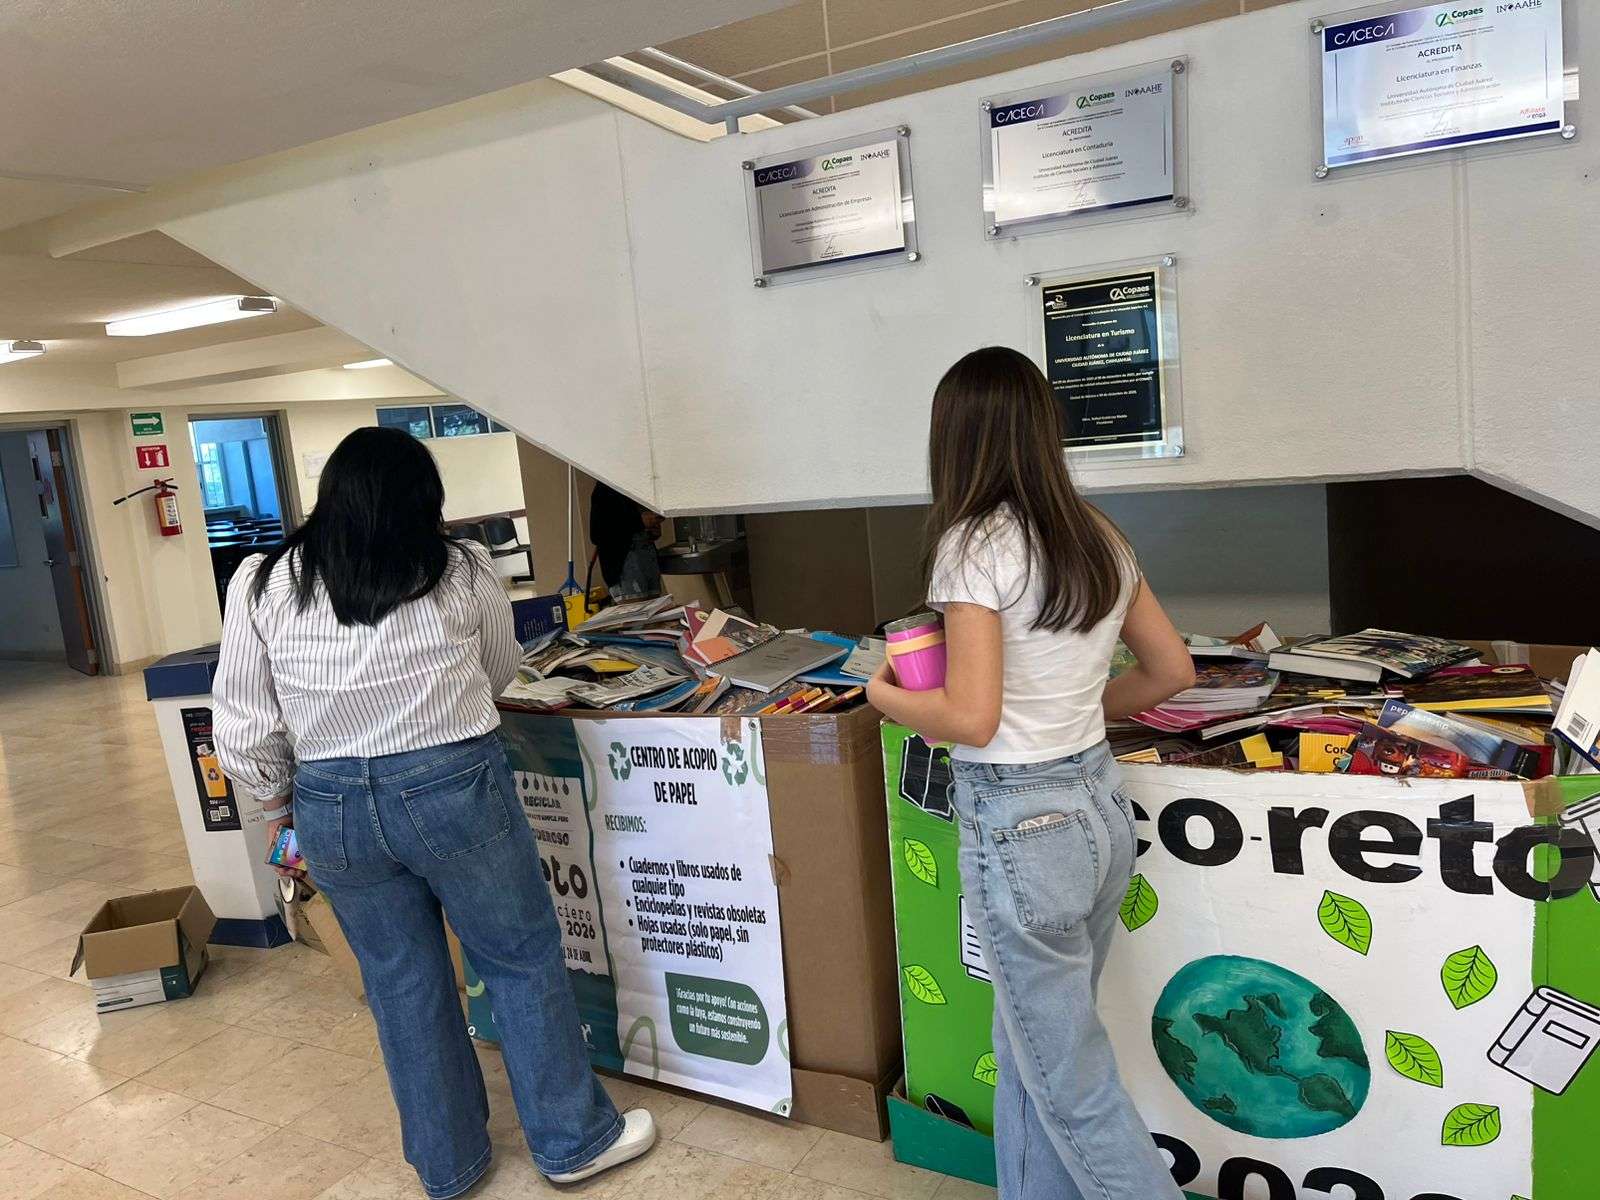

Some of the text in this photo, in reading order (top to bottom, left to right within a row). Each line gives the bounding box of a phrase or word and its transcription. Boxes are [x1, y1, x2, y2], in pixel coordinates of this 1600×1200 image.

[1334, 22, 1395, 45] CACECA
[1451, 7, 1483, 19] Copaes
[1417, 43, 1462, 58] ACREDITA
[1396, 62, 1482, 82] Licenciatura en Finanzas
[996, 104, 1044, 124] CACECA
[1089, 90, 1115, 102] Copaes
[1062, 125, 1092, 136] ACREDITA
[1042, 147, 1074, 158] Licenciatura
[1083, 141, 1113, 152] Contaduría
[758, 166, 798, 183] CACECA
[832, 155, 853, 165] Copaes
[812, 186, 836, 194] ACREDITA
[779, 209, 804, 218] Licenciatura
[1122, 285, 1150, 296] Copaes
[1065, 332, 1101, 342] Licenciatura
[1110, 328, 1135, 337] Turismo
[1055, 356, 1082, 364] UNIVERSIDAD
[630, 746, 717, 771] CENTRO DE ACOPIO
[653, 781, 698, 805] DE PAPEL
[604, 814, 647, 833] RECIBIMOS:
[1131, 794, 1594, 901] o-reto
[629, 856, 742, 881] Cuadernos y libros usados de
[632, 878, 685, 899] cualquier tipo
[634, 896, 766, 924] Enciclopedias y revistas obsoletas
[566, 920, 596, 940] 2026
[637, 915, 750, 945] Hojas usadas (solo papel, sin
[641, 936, 723, 962] protectores plásticos)
[696, 992, 704, 1003] por
[711, 995, 727, 1008] apoyo!
[727, 996, 737, 1010] Con
[737, 1000, 758, 1014] acciones
[676, 1004, 689, 1015] como
[707, 1010, 727, 1024] estamos
[727, 1015, 761, 1030] construyendo
[688, 1022, 749, 1044] un futuro más sostenible.
